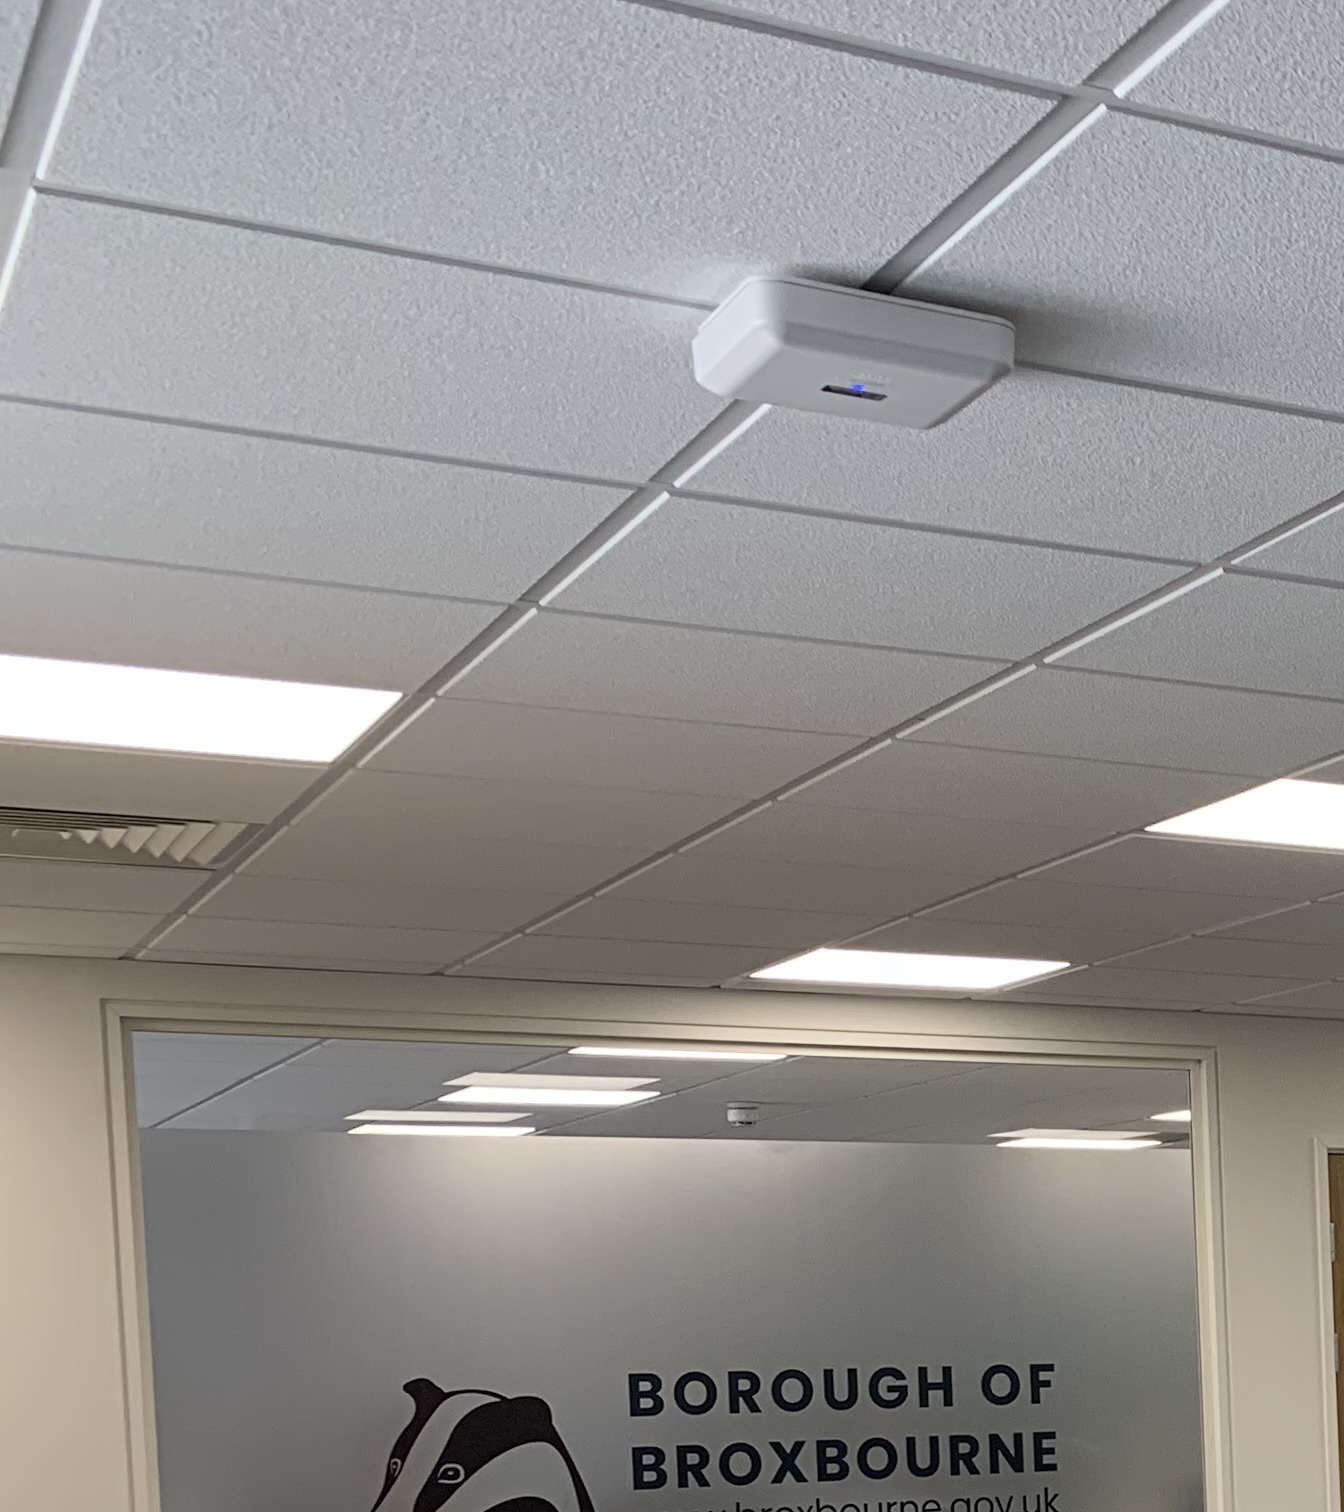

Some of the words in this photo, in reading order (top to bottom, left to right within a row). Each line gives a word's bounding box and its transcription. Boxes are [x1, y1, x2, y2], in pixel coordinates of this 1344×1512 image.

[628, 1366, 954, 1418] BOROUGH
[980, 1363, 1055, 1406] OF
[632, 1431, 1058, 1490] BROXBOURNE
